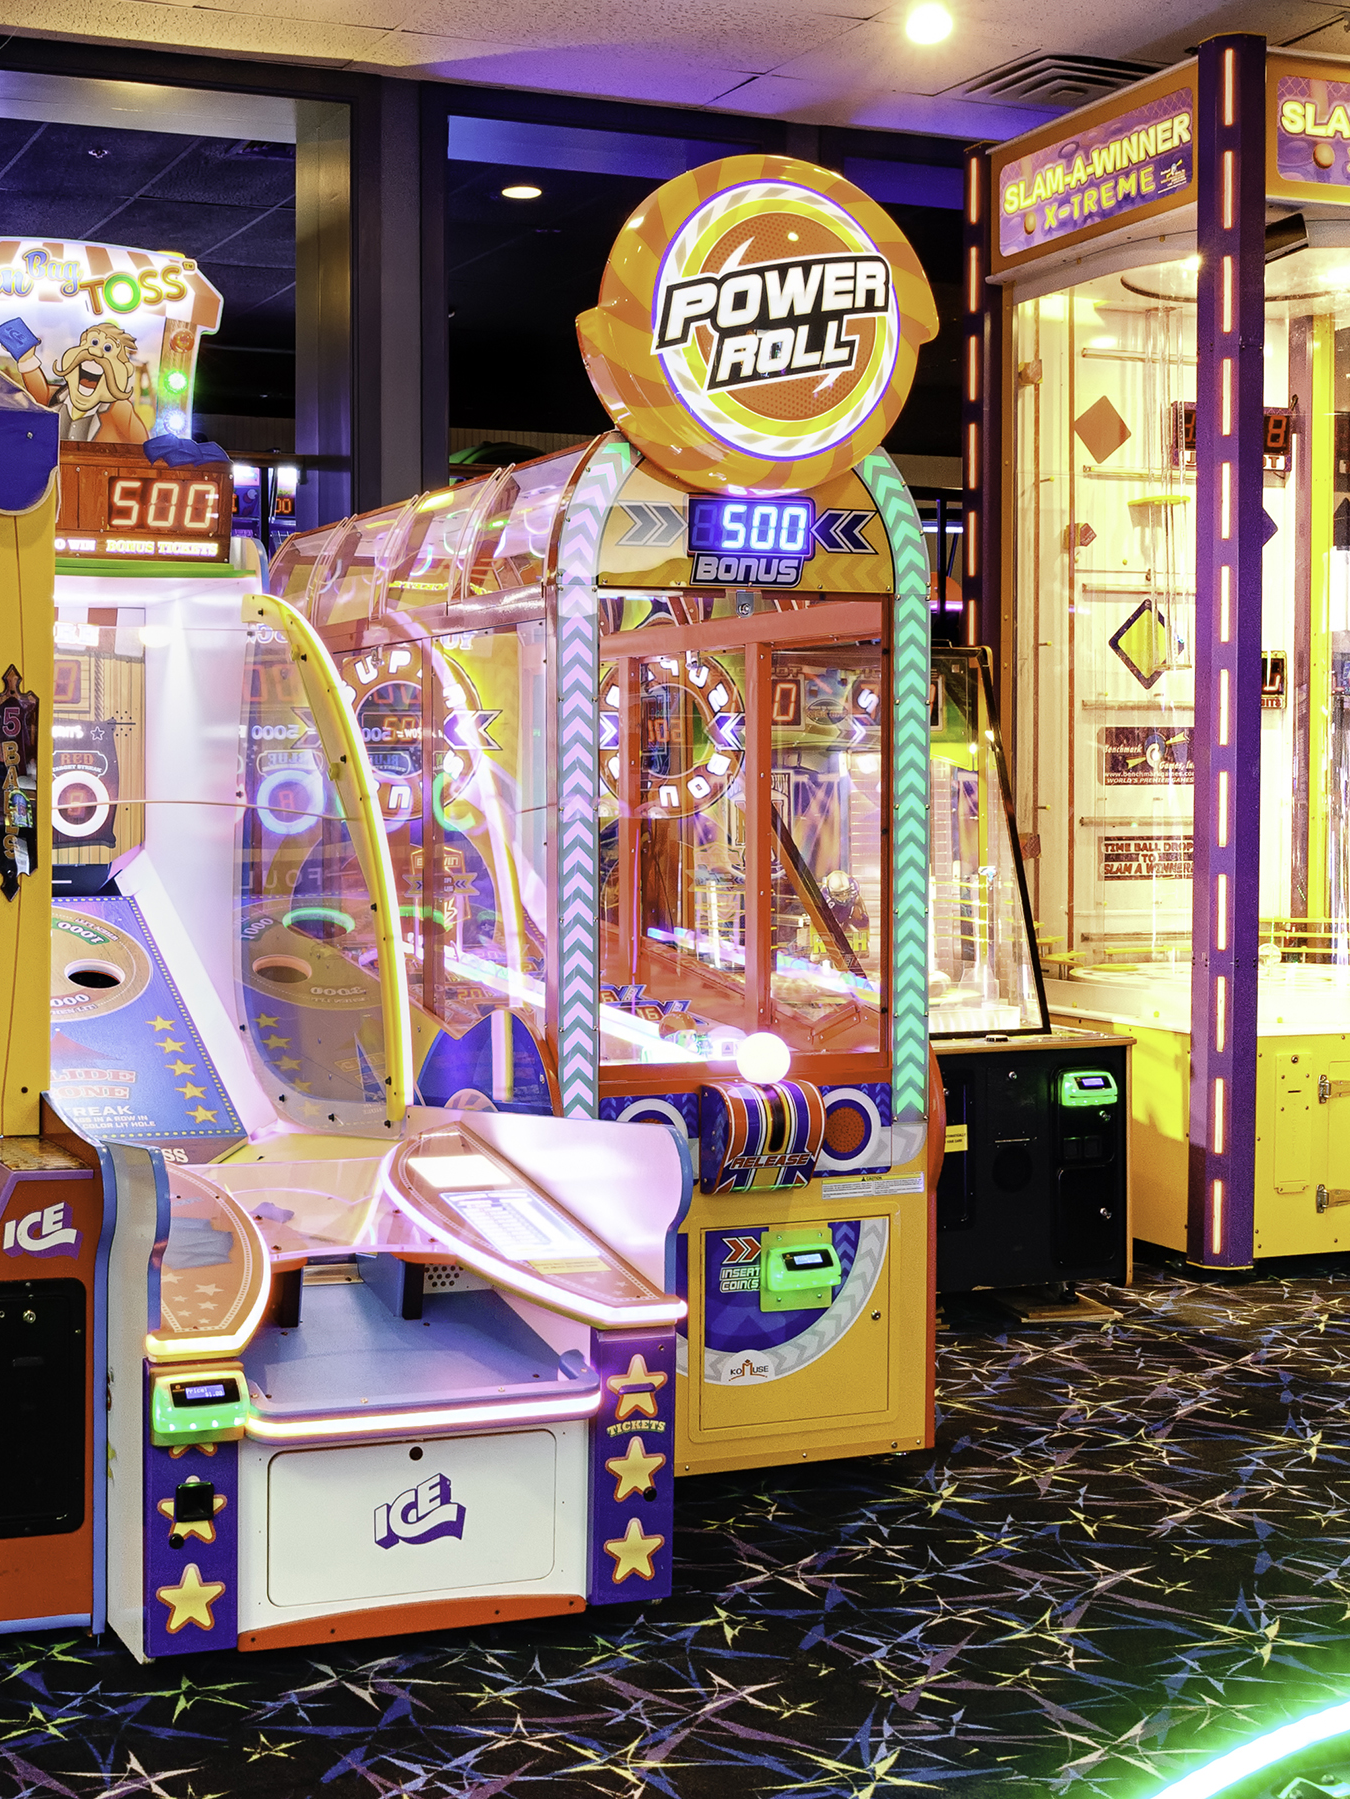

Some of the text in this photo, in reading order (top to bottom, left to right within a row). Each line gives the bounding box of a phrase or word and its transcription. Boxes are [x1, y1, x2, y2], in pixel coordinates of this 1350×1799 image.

[1003, 112, 1192, 214] SLAM-A-WINNER
[1044, 166, 1155, 230] X-TREME
[23, 249, 82, 296] Bag
[79, 265, 187, 315] TOSS
[665, 260, 889, 342] POWER
[716, 321, 851, 382] ROLL
[112, 480, 216, 528] 500
[721, 503, 808, 551] 500
[71, 540, 97, 551] WIN
[106, 539, 154, 554] BONUS
[158, 541, 218, 556] TICKETS
[696, 556, 799, 582] BONUS
[2, 707, 21, 737] 5
[60, 753, 95, 766] RED
[1134, 843, 1161, 852] BALL
[1140, 853, 1156, 863] TO
[1104, 863, 1133, 875] SLAM
[731, 1154, 811, 1169] RELEASE
[3, 1202, 81, 1256] ICE
[721, 1267, 761, 1279] INSERT
[607, 1418, 666, 1437] TICKETS
[374, 1472, 467, 1550] ICE
